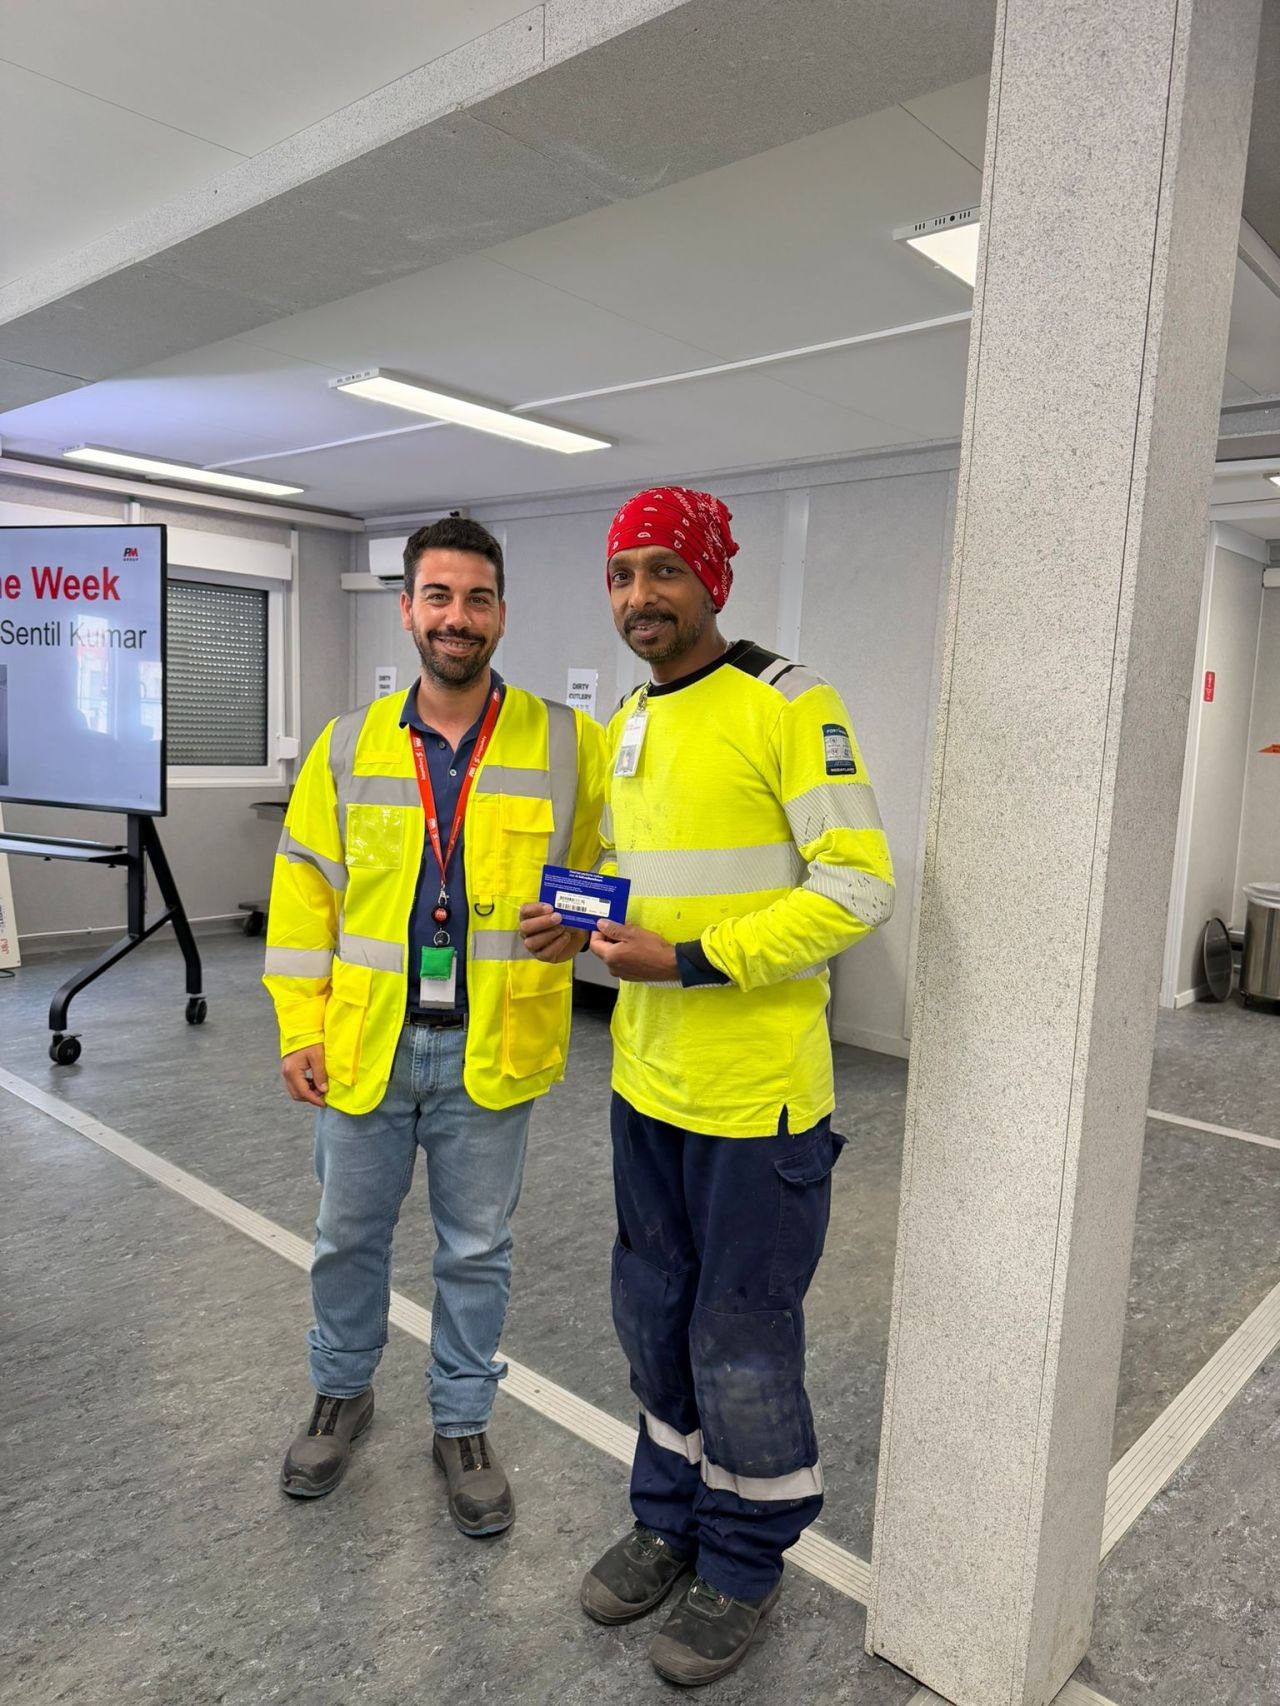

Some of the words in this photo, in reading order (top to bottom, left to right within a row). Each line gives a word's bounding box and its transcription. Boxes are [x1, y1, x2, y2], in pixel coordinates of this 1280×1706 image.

[0, 574, 21, 600] e
[31, 566, 121, 601] Week
[0, 619, 61, 647] Sentil
[70, 621, 147, 649] Kumar
